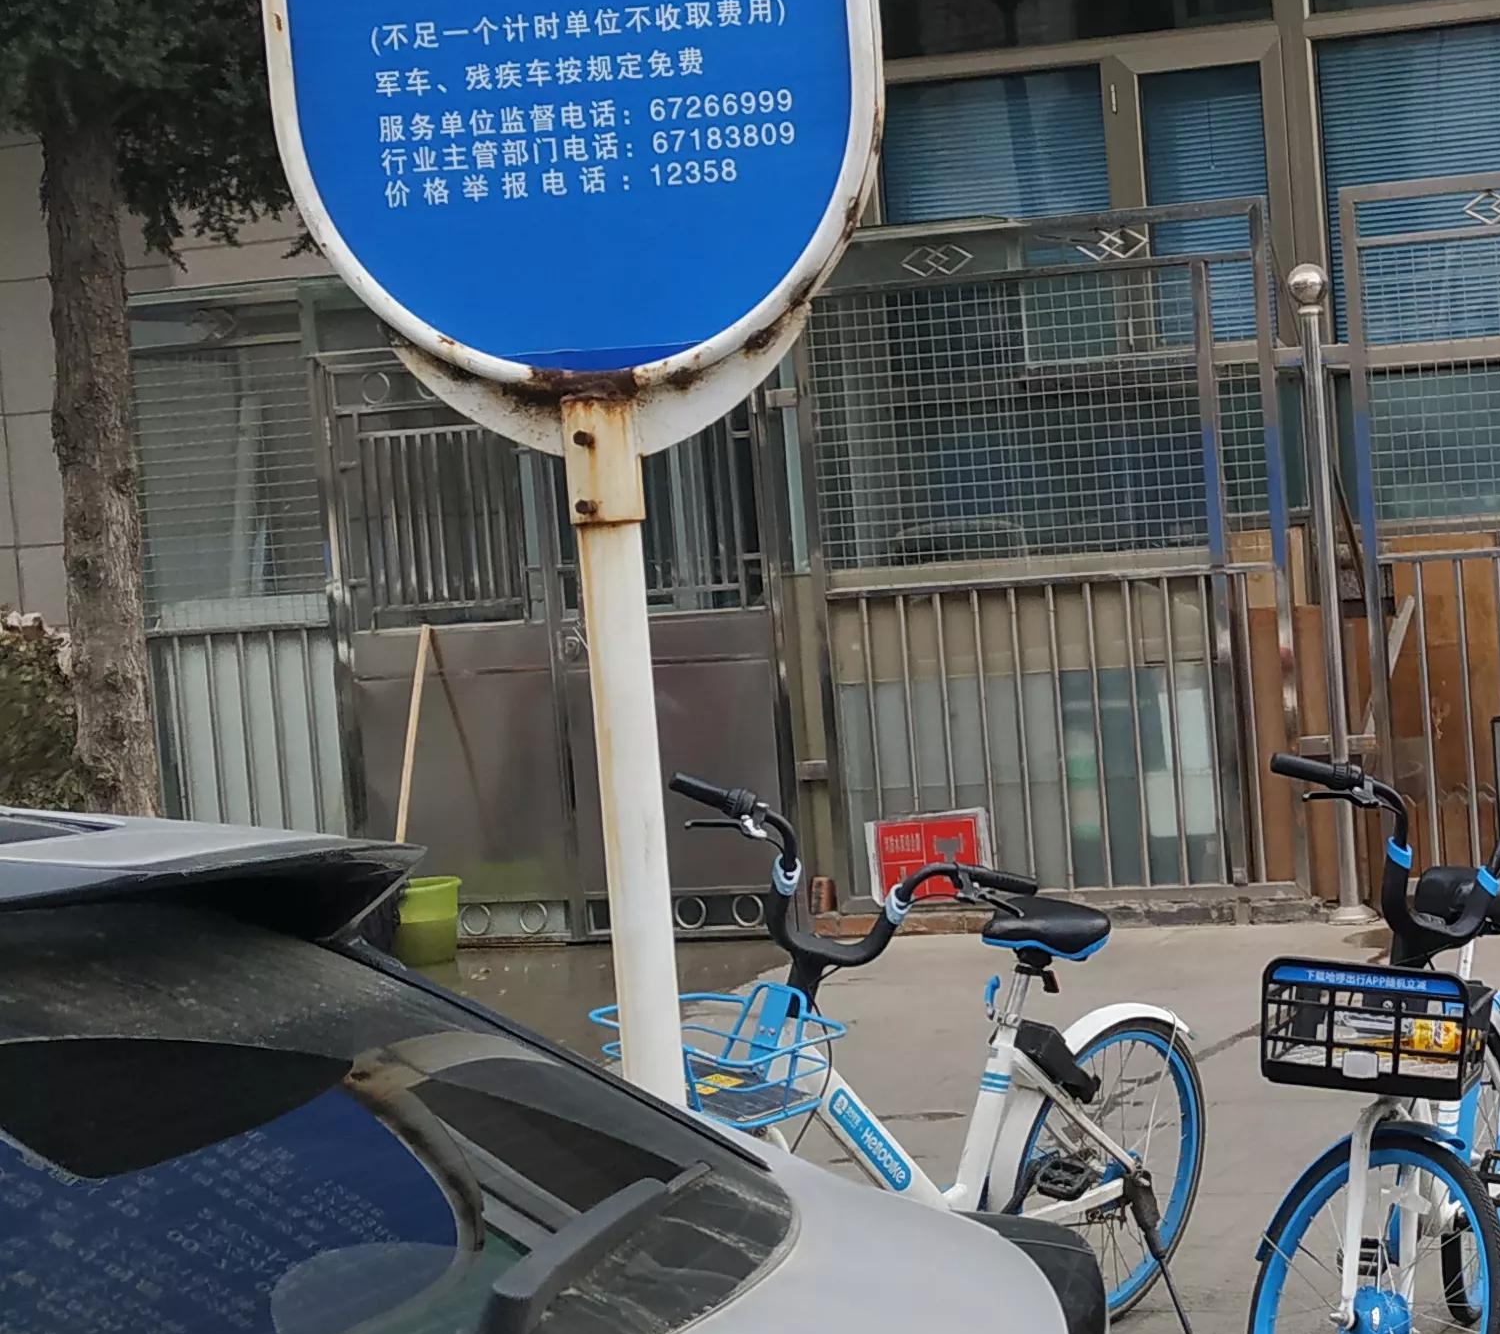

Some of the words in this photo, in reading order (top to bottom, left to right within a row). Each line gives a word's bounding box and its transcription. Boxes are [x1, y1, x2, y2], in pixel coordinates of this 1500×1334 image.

[375, 47, 703, 98] 军车、残疾车按规定免费
